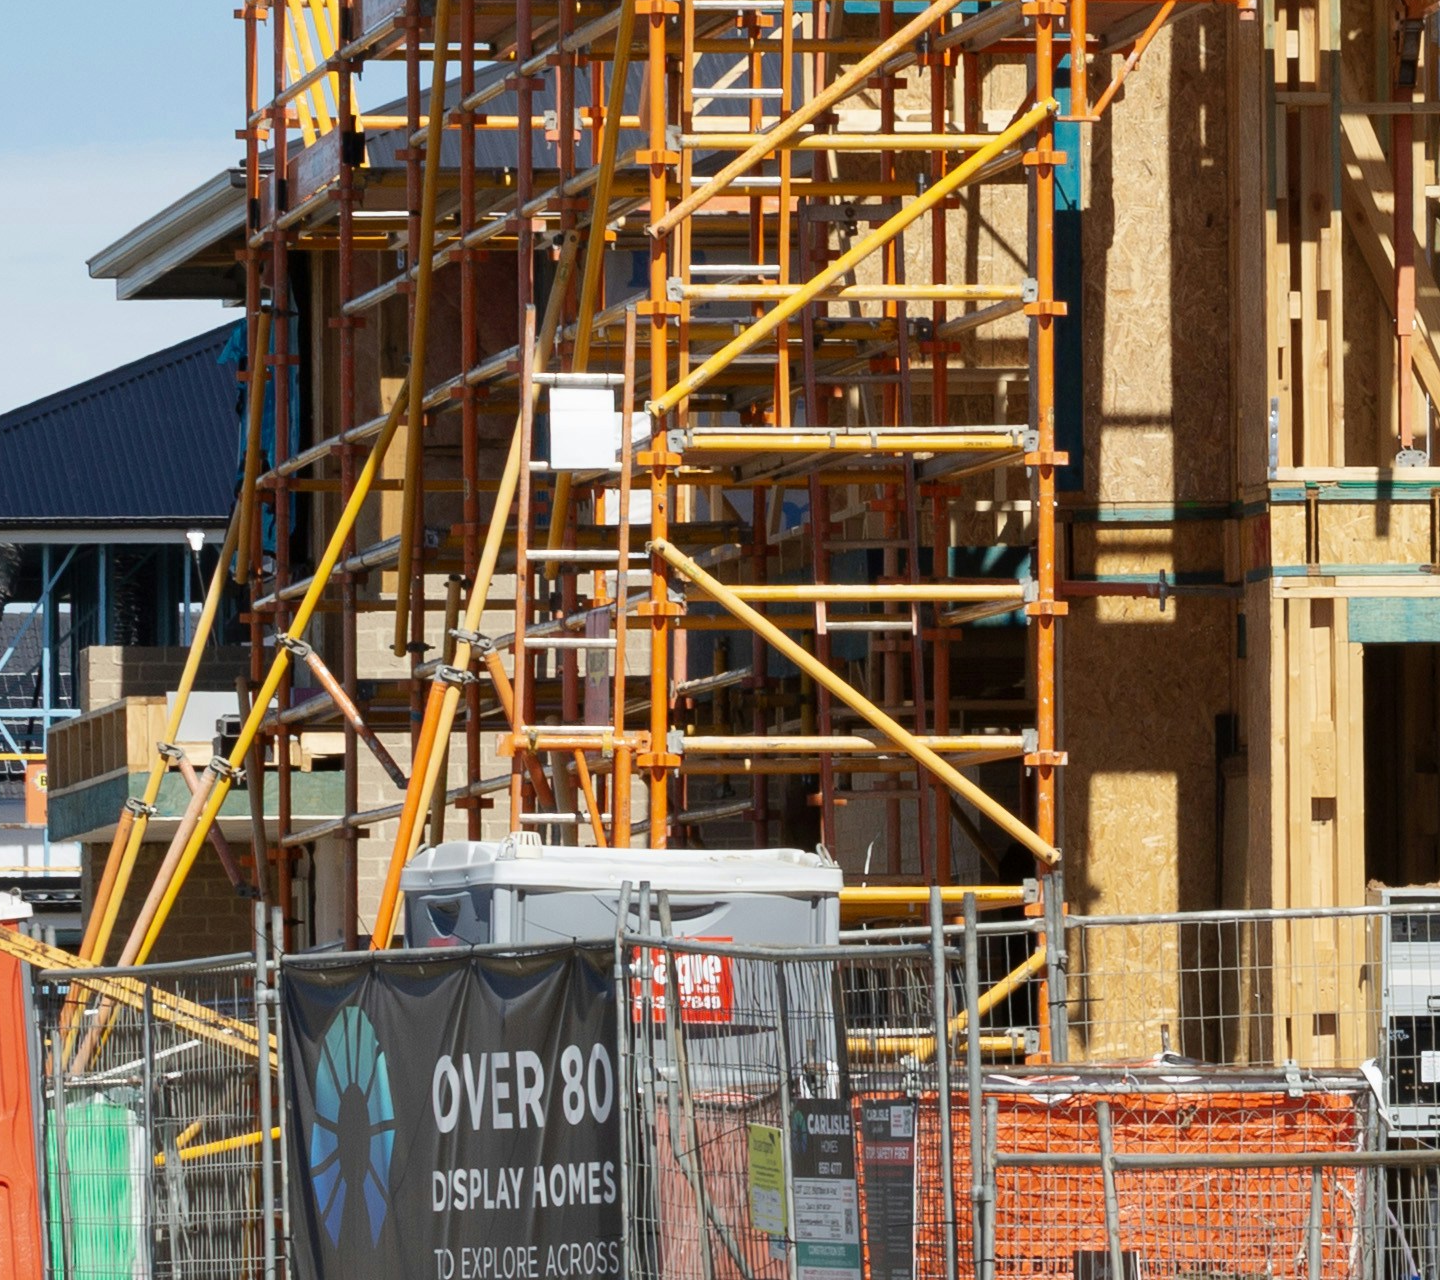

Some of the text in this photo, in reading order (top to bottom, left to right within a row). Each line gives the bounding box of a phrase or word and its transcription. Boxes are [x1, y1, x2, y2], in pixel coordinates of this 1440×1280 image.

[432, 1043, 613, 1133] OVER 80
[807, 1113, 850, 1135] CARLISLE
[432, 1161, 617, 1212] DISPLAY HOMES
[461, 1246, 539, 1279] EXPLORE
[545, 1241, 620, 1277] ACROSS
